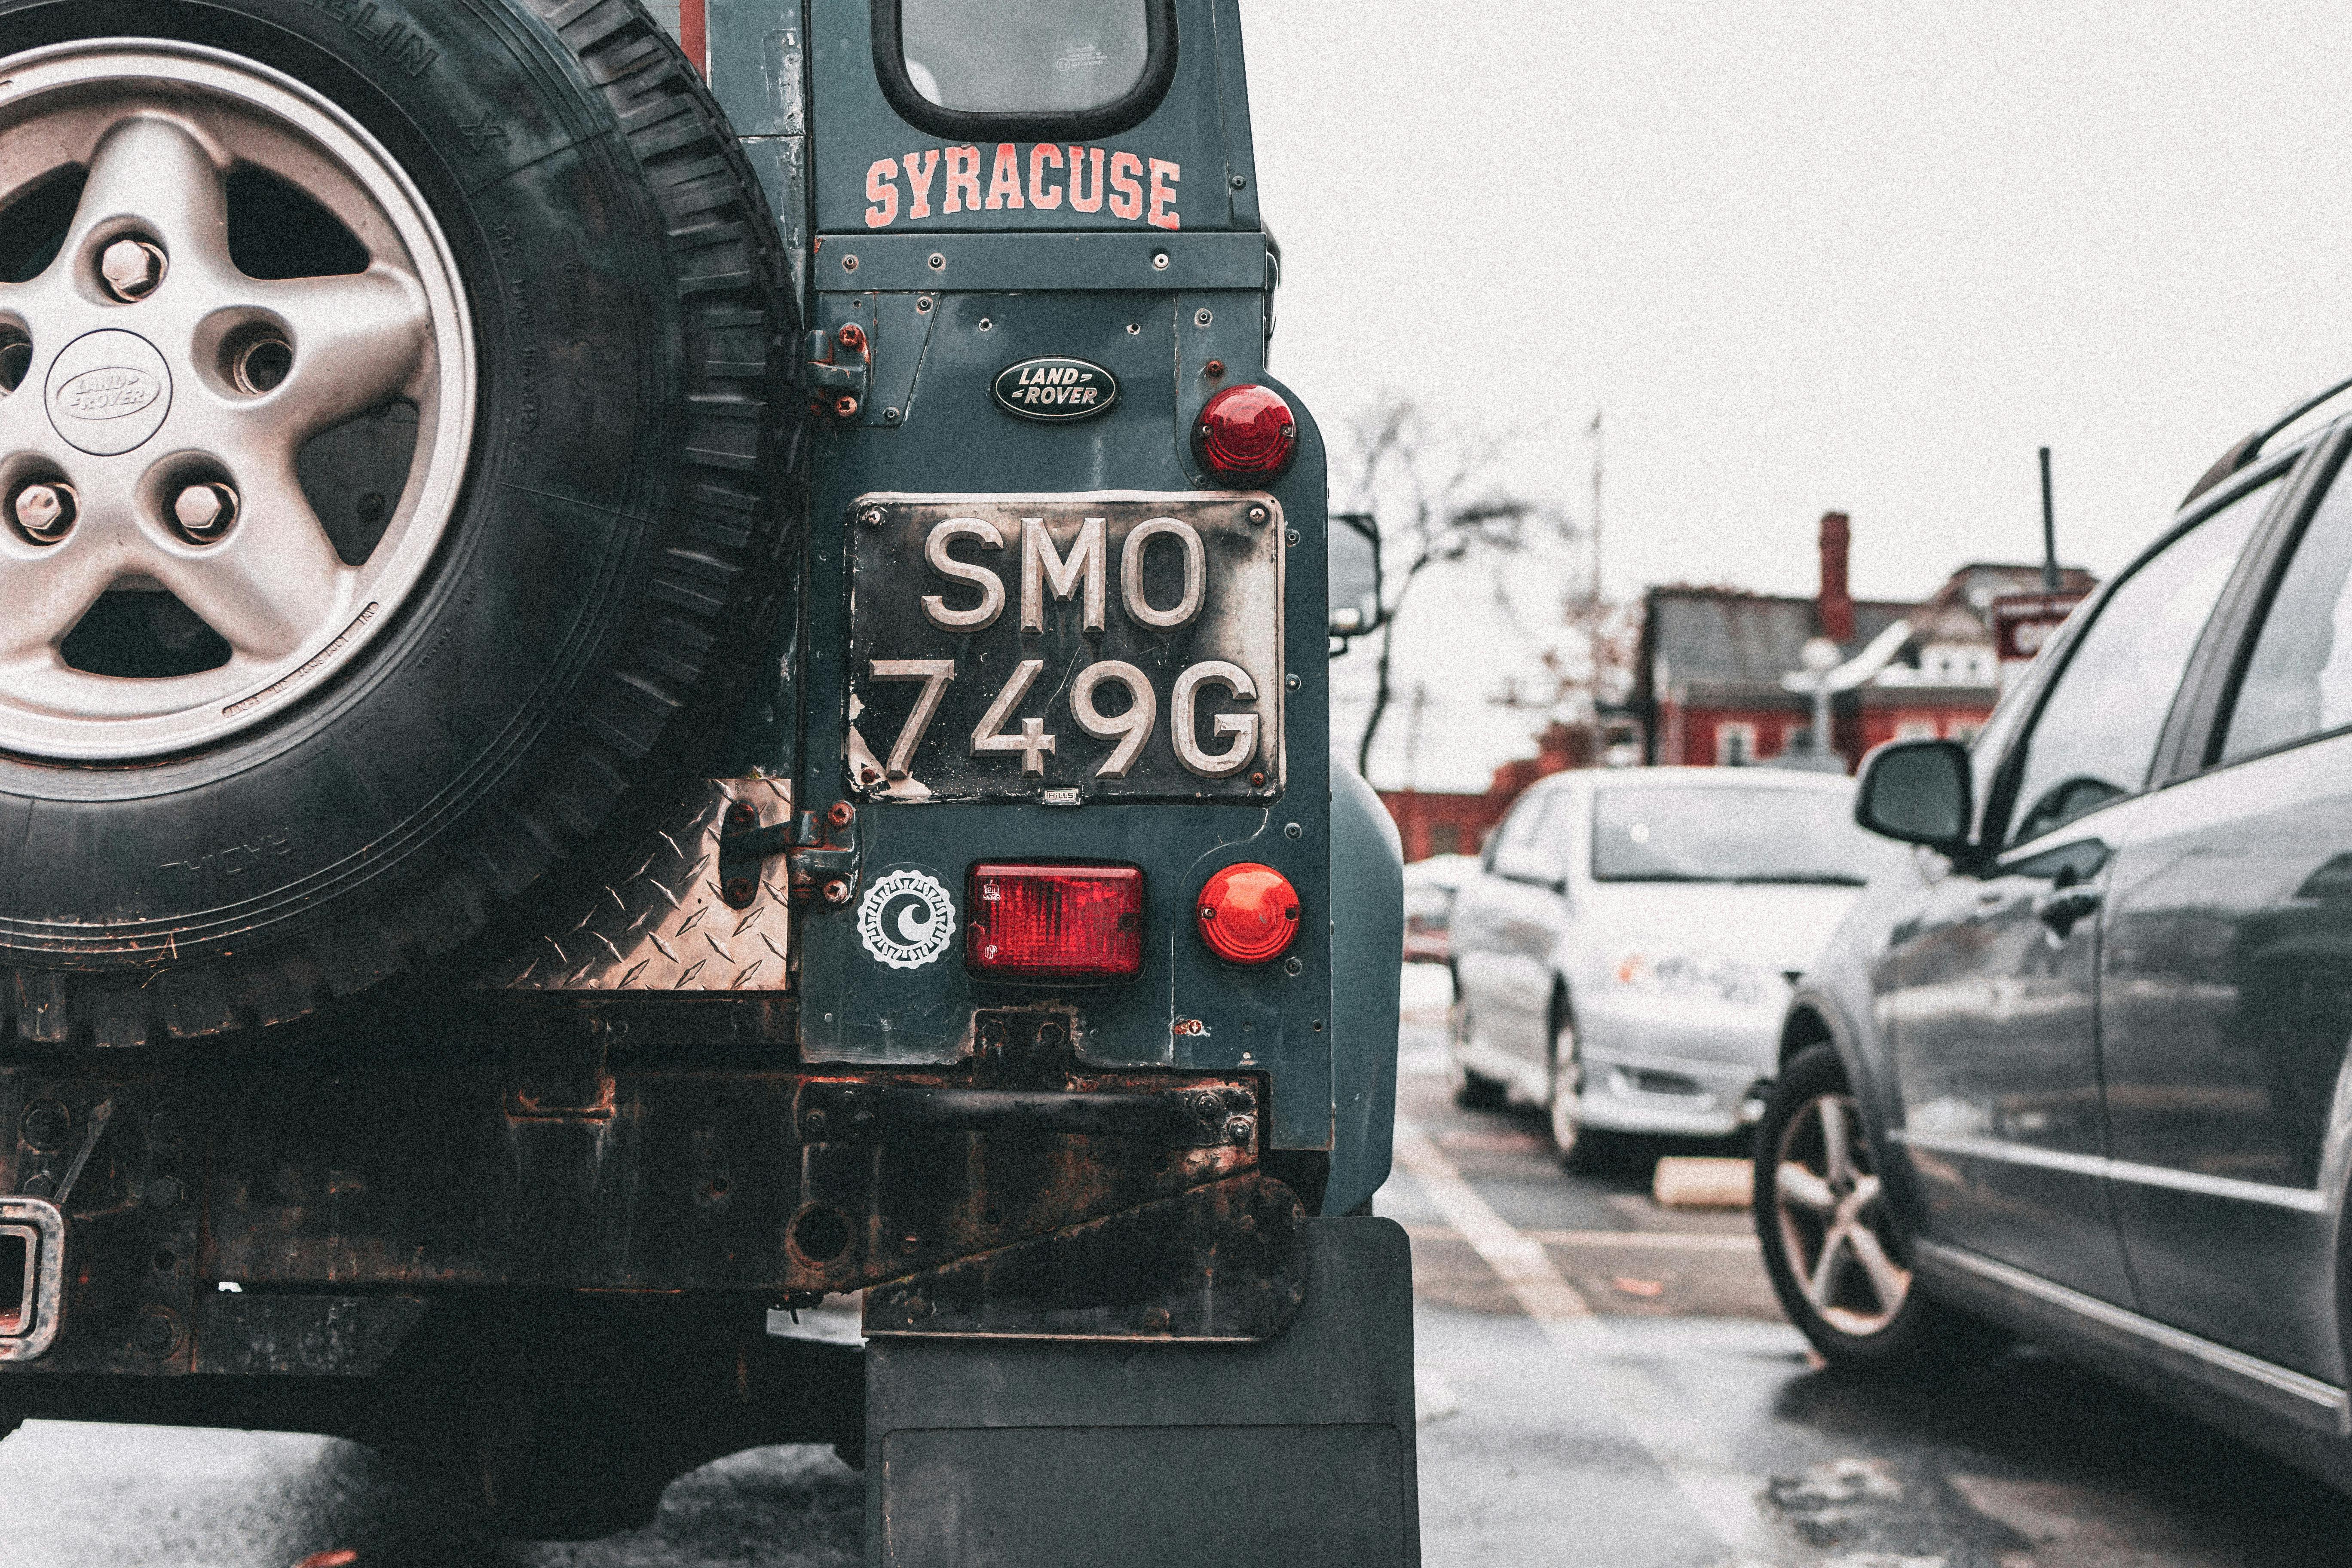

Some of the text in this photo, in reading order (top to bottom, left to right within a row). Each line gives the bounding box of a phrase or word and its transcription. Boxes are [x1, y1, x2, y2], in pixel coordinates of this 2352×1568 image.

[865, 143, 1180, 231] SYRACUSE
[1019, 368, 1078, 385] LAND
[1024, 387, 1097, 404] ROVER
[921, 516, 1206, 632] SMO
[869, 659, 1259, 779] 749G
